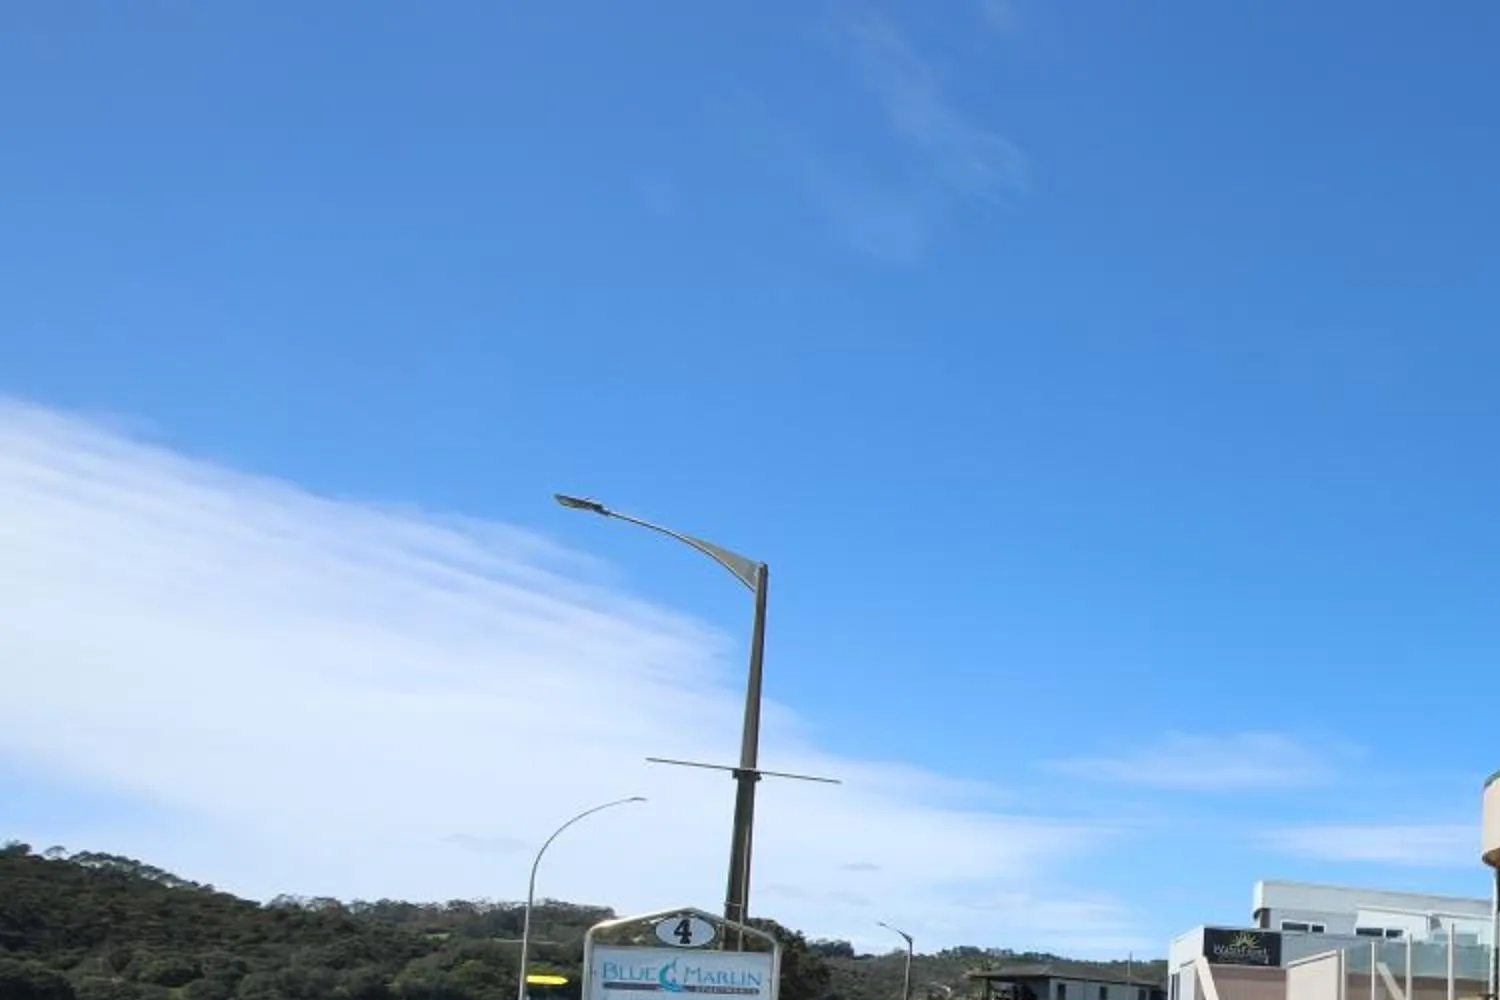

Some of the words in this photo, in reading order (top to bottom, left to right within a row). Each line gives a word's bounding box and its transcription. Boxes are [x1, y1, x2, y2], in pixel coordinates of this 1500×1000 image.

[673, 918, 693, 945] 4
[602, 960, 657, 981] BLUE
[684, 965, 762, 986] MARLIN
